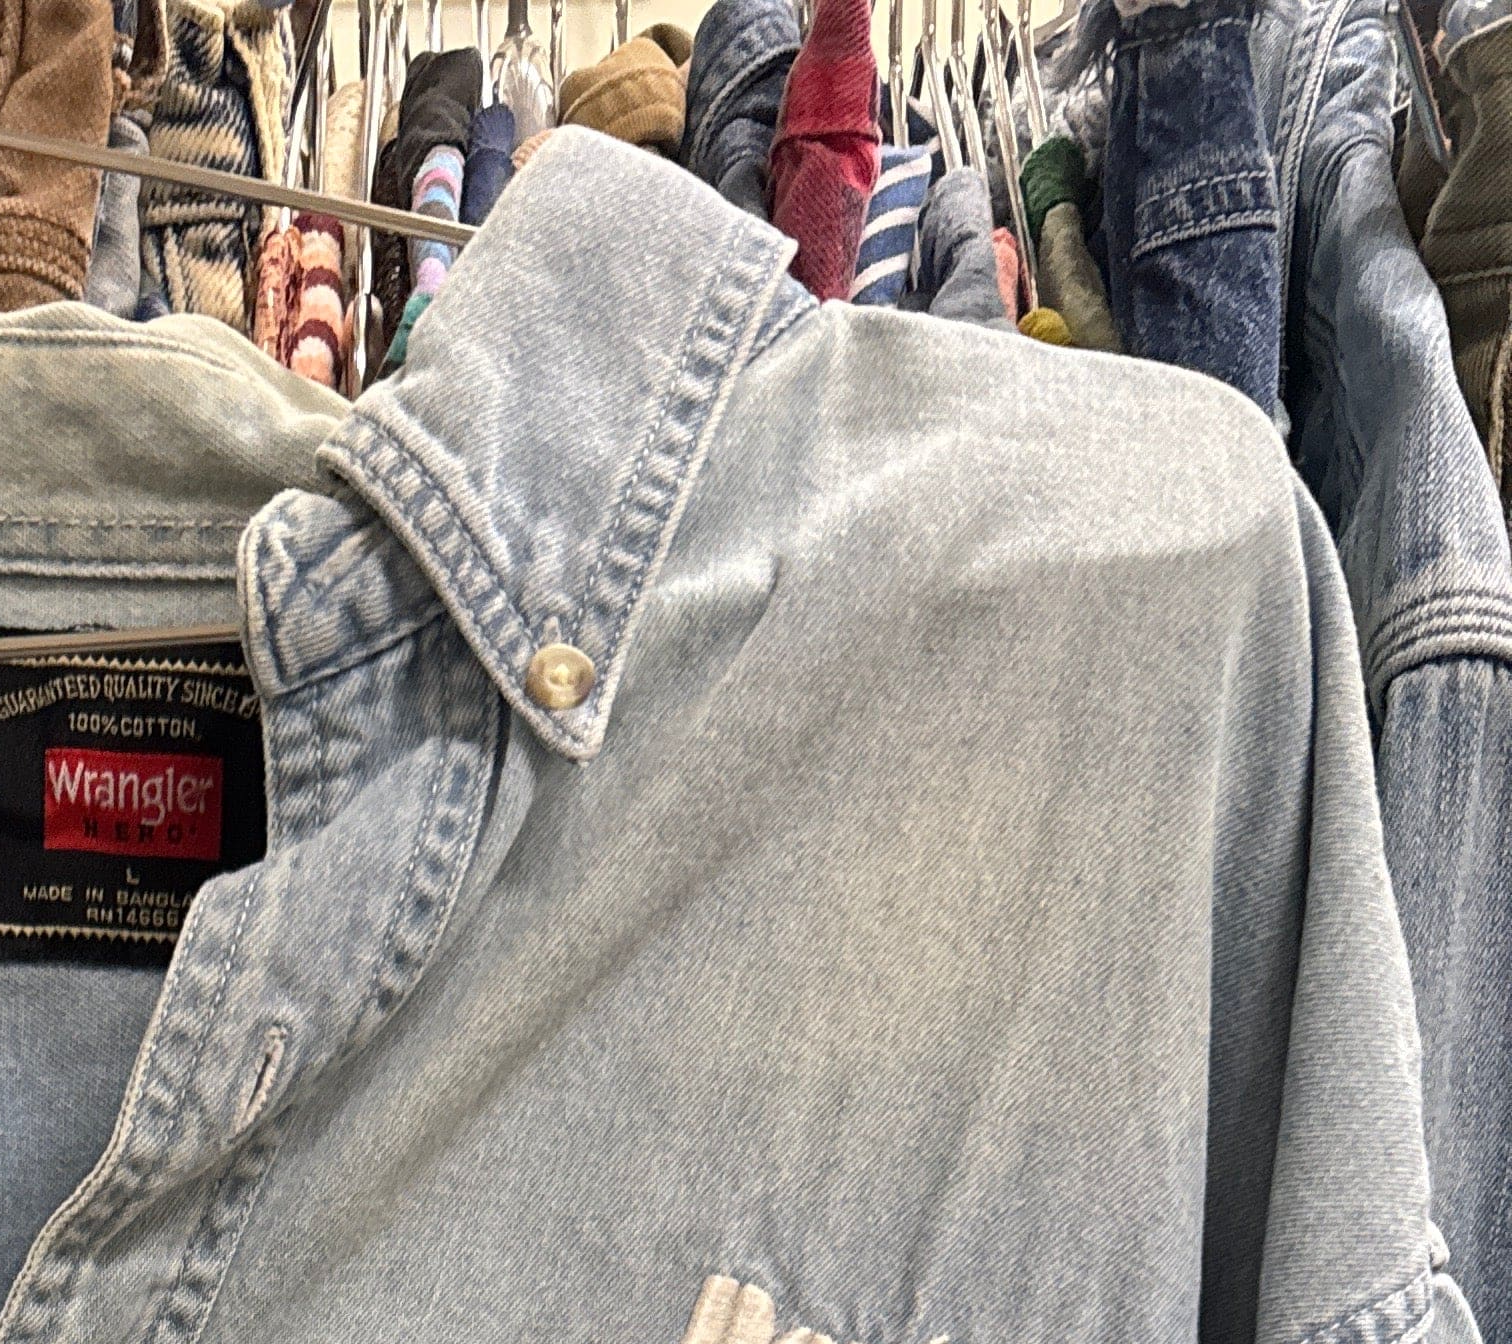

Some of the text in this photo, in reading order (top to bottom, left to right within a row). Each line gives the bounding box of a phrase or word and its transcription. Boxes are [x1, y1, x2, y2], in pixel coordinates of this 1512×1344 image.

[103, 674, 181, 703] QUALITY
[180, 679, 240, 714] SINCE
[48, 759, 214, 826] Wrangler
[125, 867, 140, 886] L
[22, 884, 195, 909] MADE IN BANGLA
